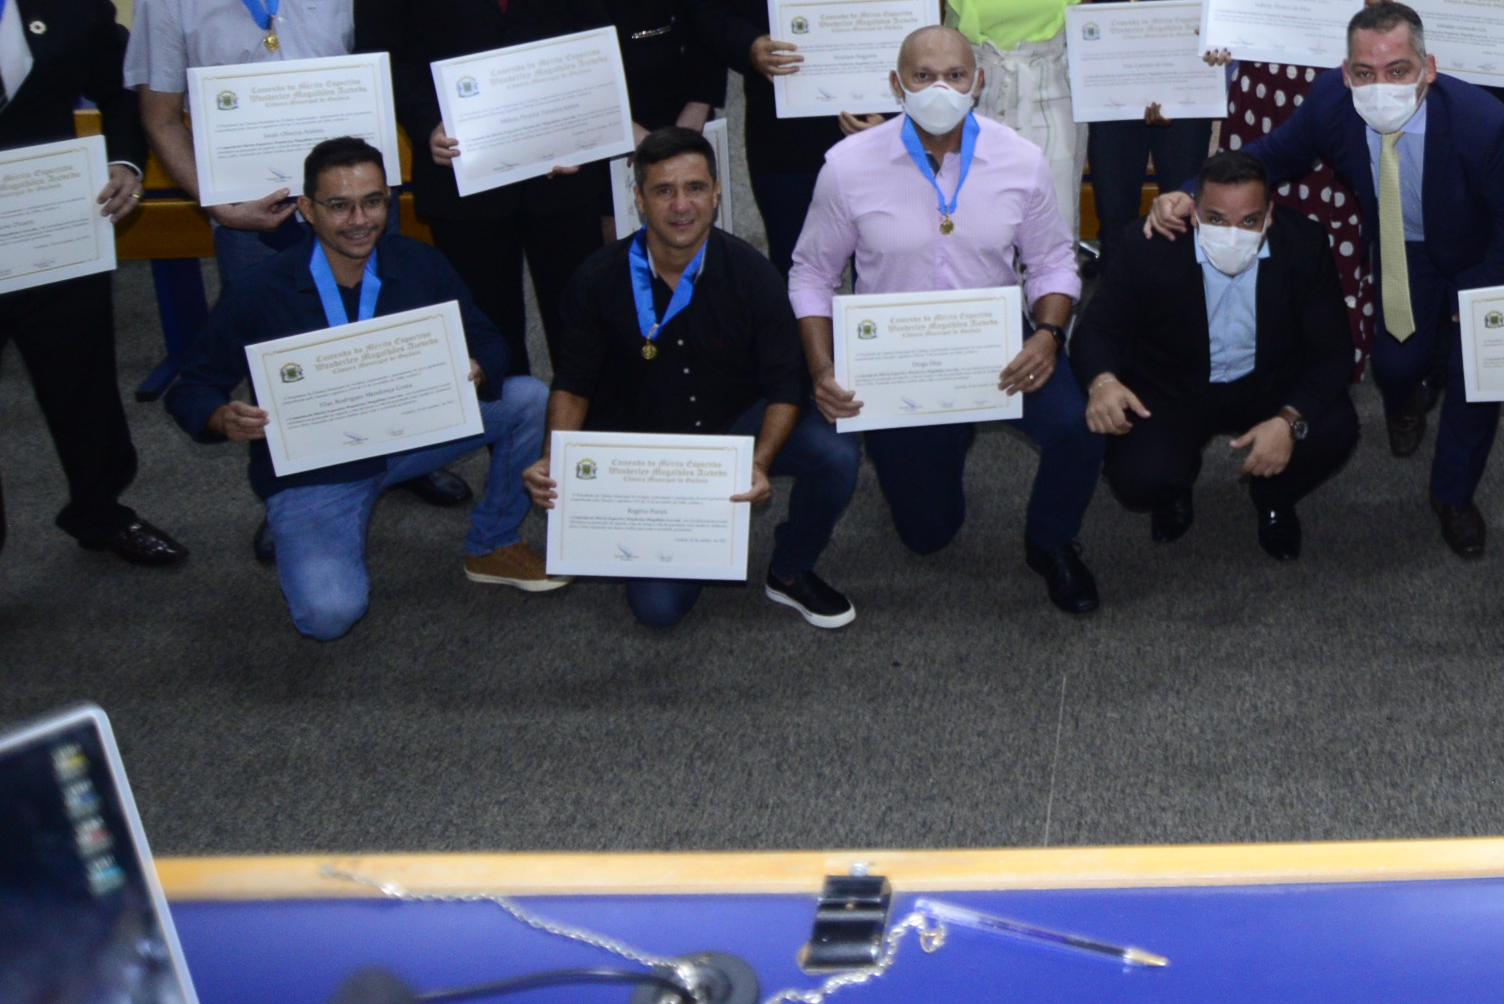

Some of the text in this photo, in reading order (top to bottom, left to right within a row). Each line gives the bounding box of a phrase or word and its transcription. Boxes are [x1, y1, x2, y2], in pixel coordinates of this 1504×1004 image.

[314, 348, 350, 361] Comenda
[392, 332, 432, 345] Esportivo
[314, 355, 358, 370] Wanderley
[406, 338, 439, 351] Azevedo
[335, 394, 363, 404] Rodrigues
[686, 461, 722, 469] Esportivo
[609, 467, 649, 476] Wanderley
